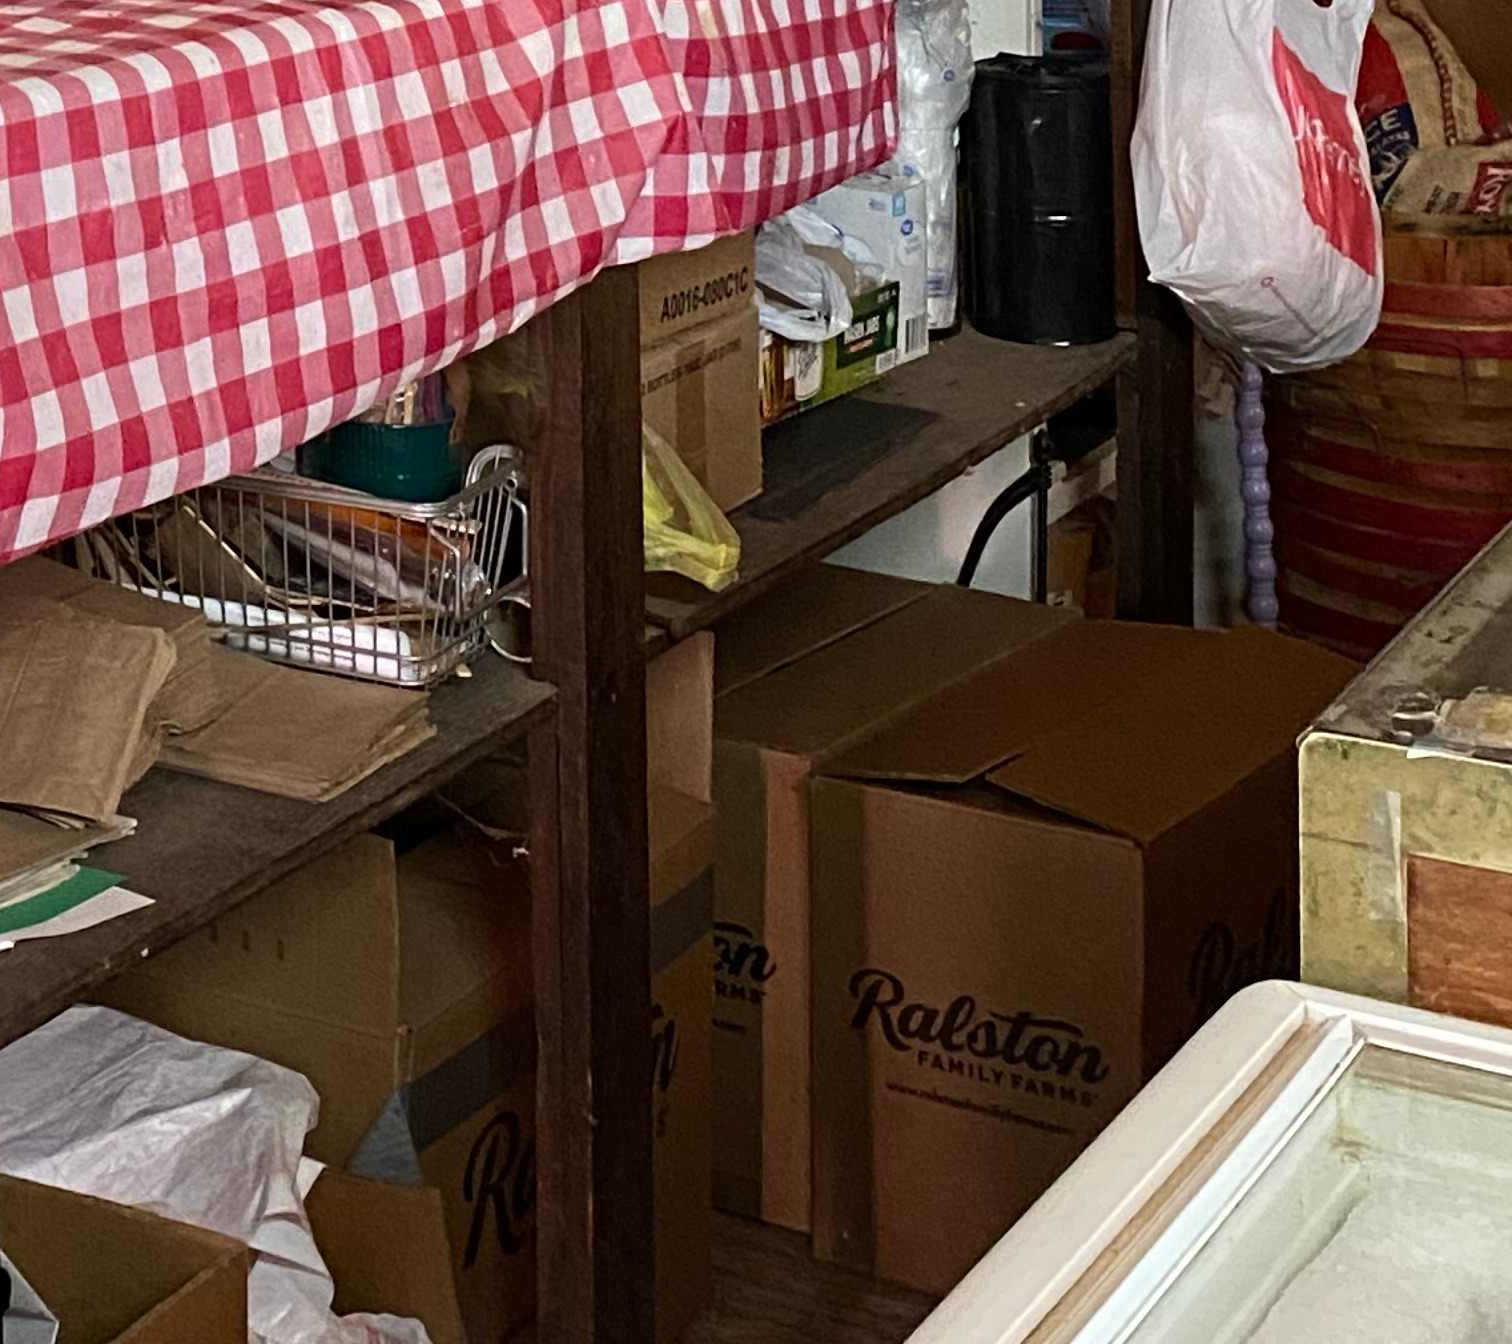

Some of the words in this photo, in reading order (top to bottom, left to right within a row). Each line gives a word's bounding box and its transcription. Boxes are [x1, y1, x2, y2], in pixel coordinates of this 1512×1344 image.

[849, 968, 1109, 1084] Ralston
[917, 1051, 1005, 1085] FAMILY
[1010, 1073, 1094, 1109] FARMS
